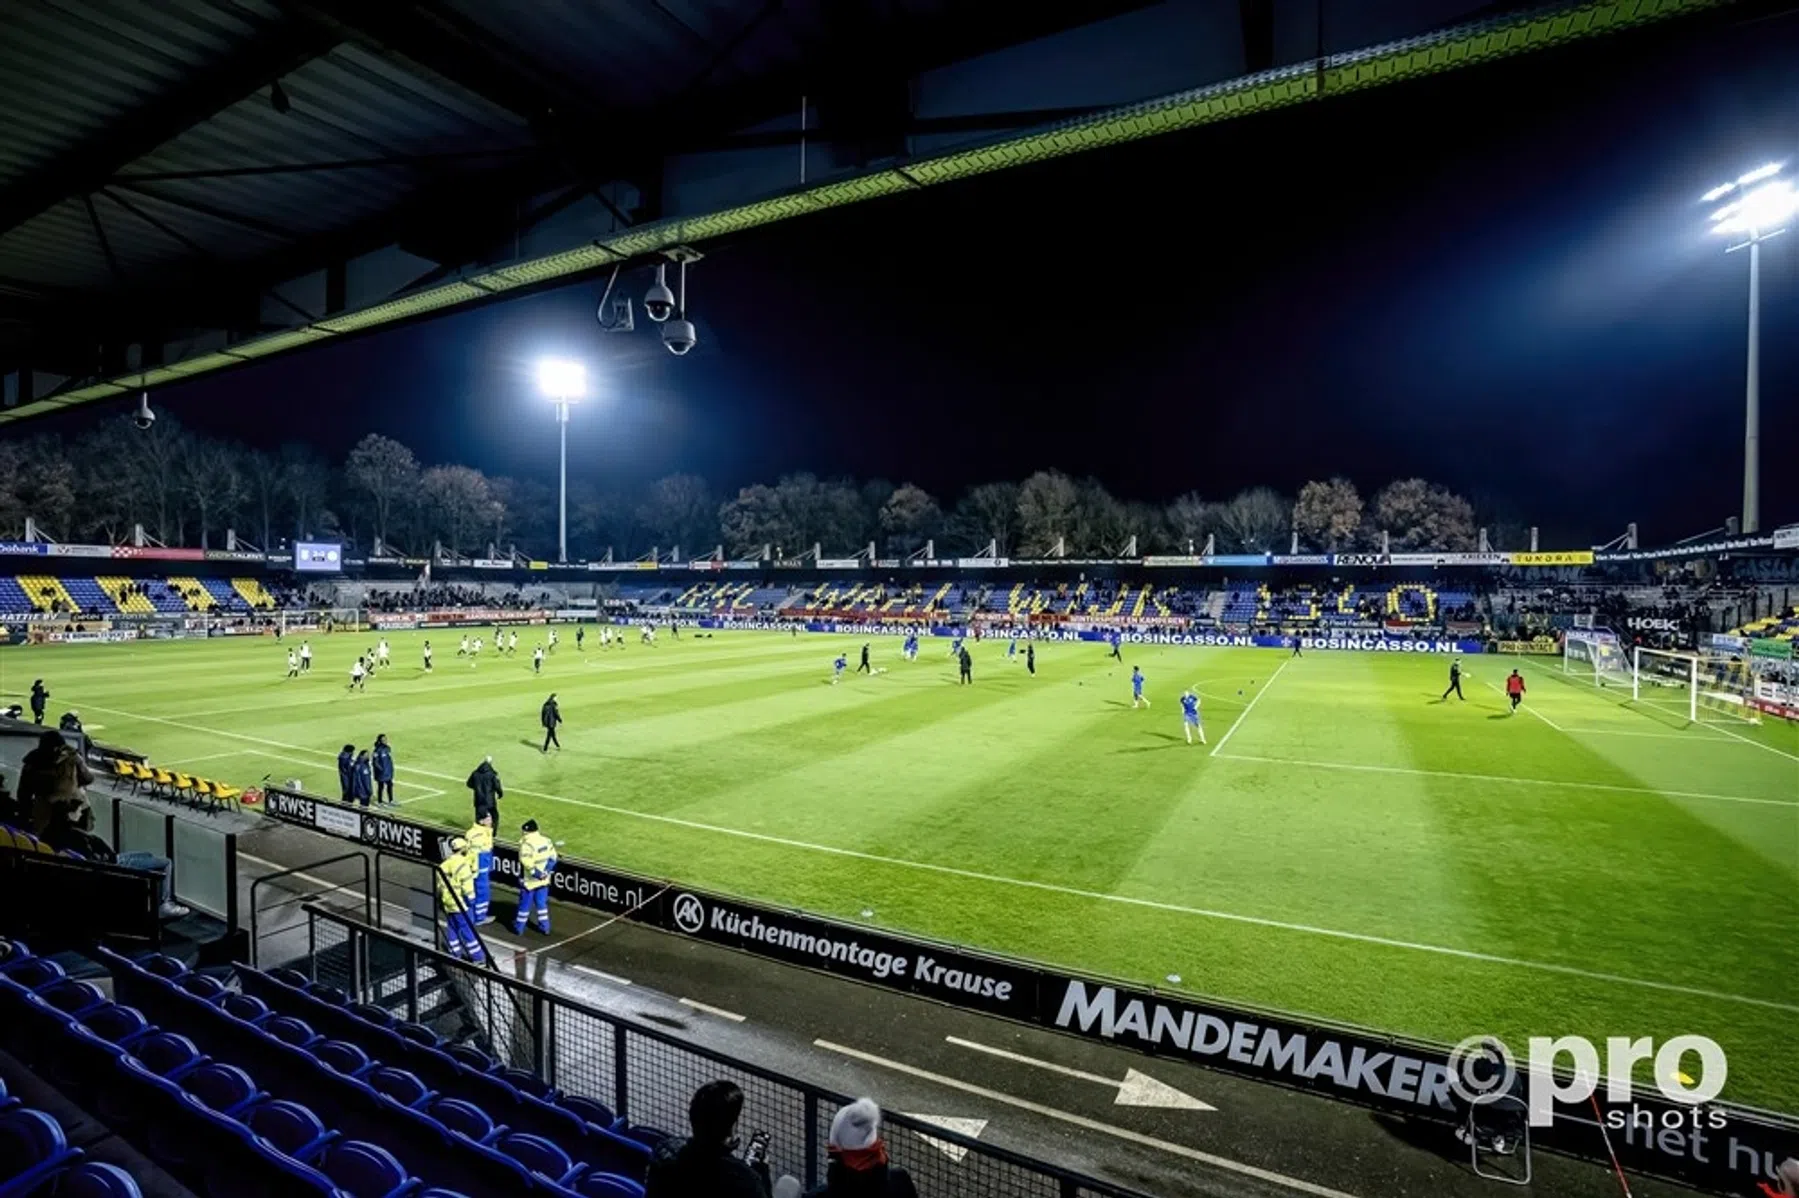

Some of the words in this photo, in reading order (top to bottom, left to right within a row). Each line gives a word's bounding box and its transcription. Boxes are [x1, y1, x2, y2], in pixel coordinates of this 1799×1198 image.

[835, 624, 934, 636] BOSINCASSO.NL
[1121, 632, 1257, 647] BOSINCASSO.NL
[1301, 638, 1463, 653] BOSINCASSO.NL
[278, 794, 314, 820] RWSE
[379, 820, 422, 849] RWSE
[710, 906, 909, 978] Küchenmontage
[914, 955, 1013, 1001] Krause
[1626, 1112, 1710, 1164] het
